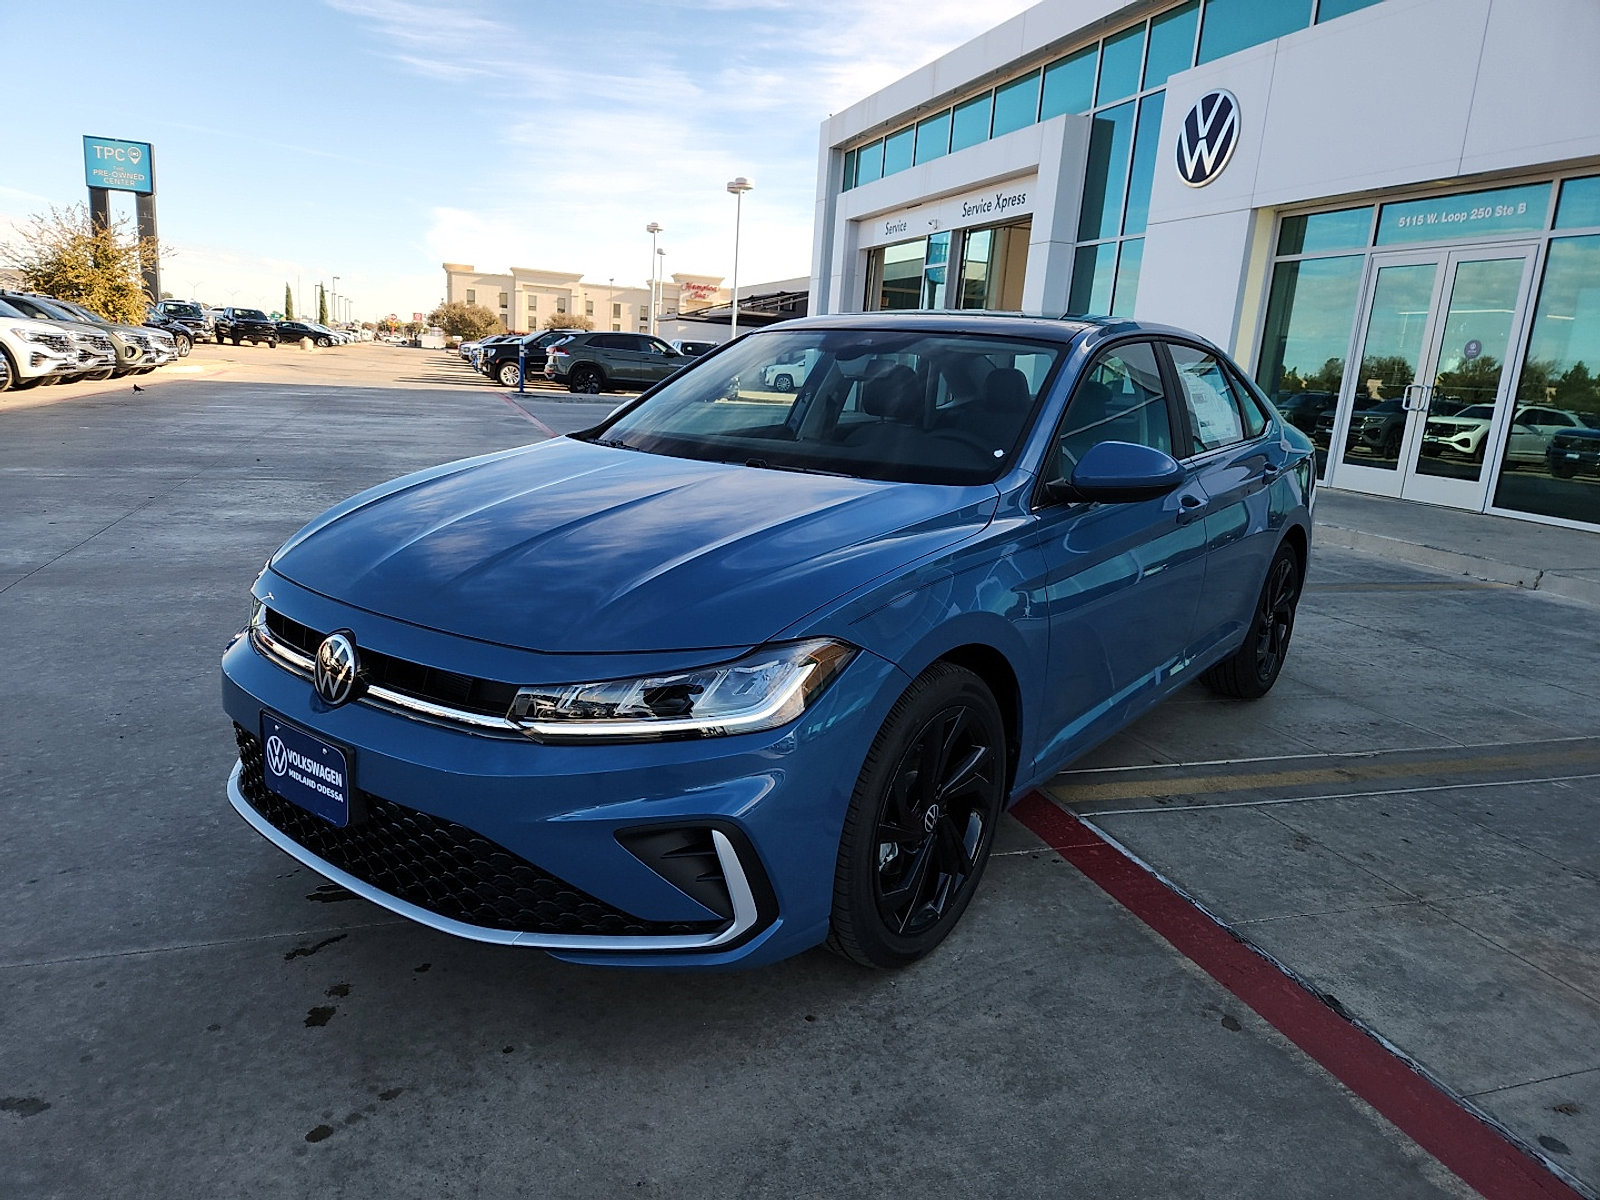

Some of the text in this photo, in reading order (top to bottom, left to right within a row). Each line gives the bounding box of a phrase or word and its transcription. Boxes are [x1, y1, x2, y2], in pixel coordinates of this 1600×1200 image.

[92, 145, 126, 161] TPC
[93, 168, 145, 181] PRE-OWNED
[103, 177, 136, 186] CENTER
[961, 192, 1026, 218] Service Xpress
[1398, 202, 1527, 228] 5115 W. Loop 250 Ste B
[885, 219, 907, 236] Service
[286, 747, 343, 788] VOLKSWAGEN
[288, 768, 344, 803] MIDLAND ODESSA
